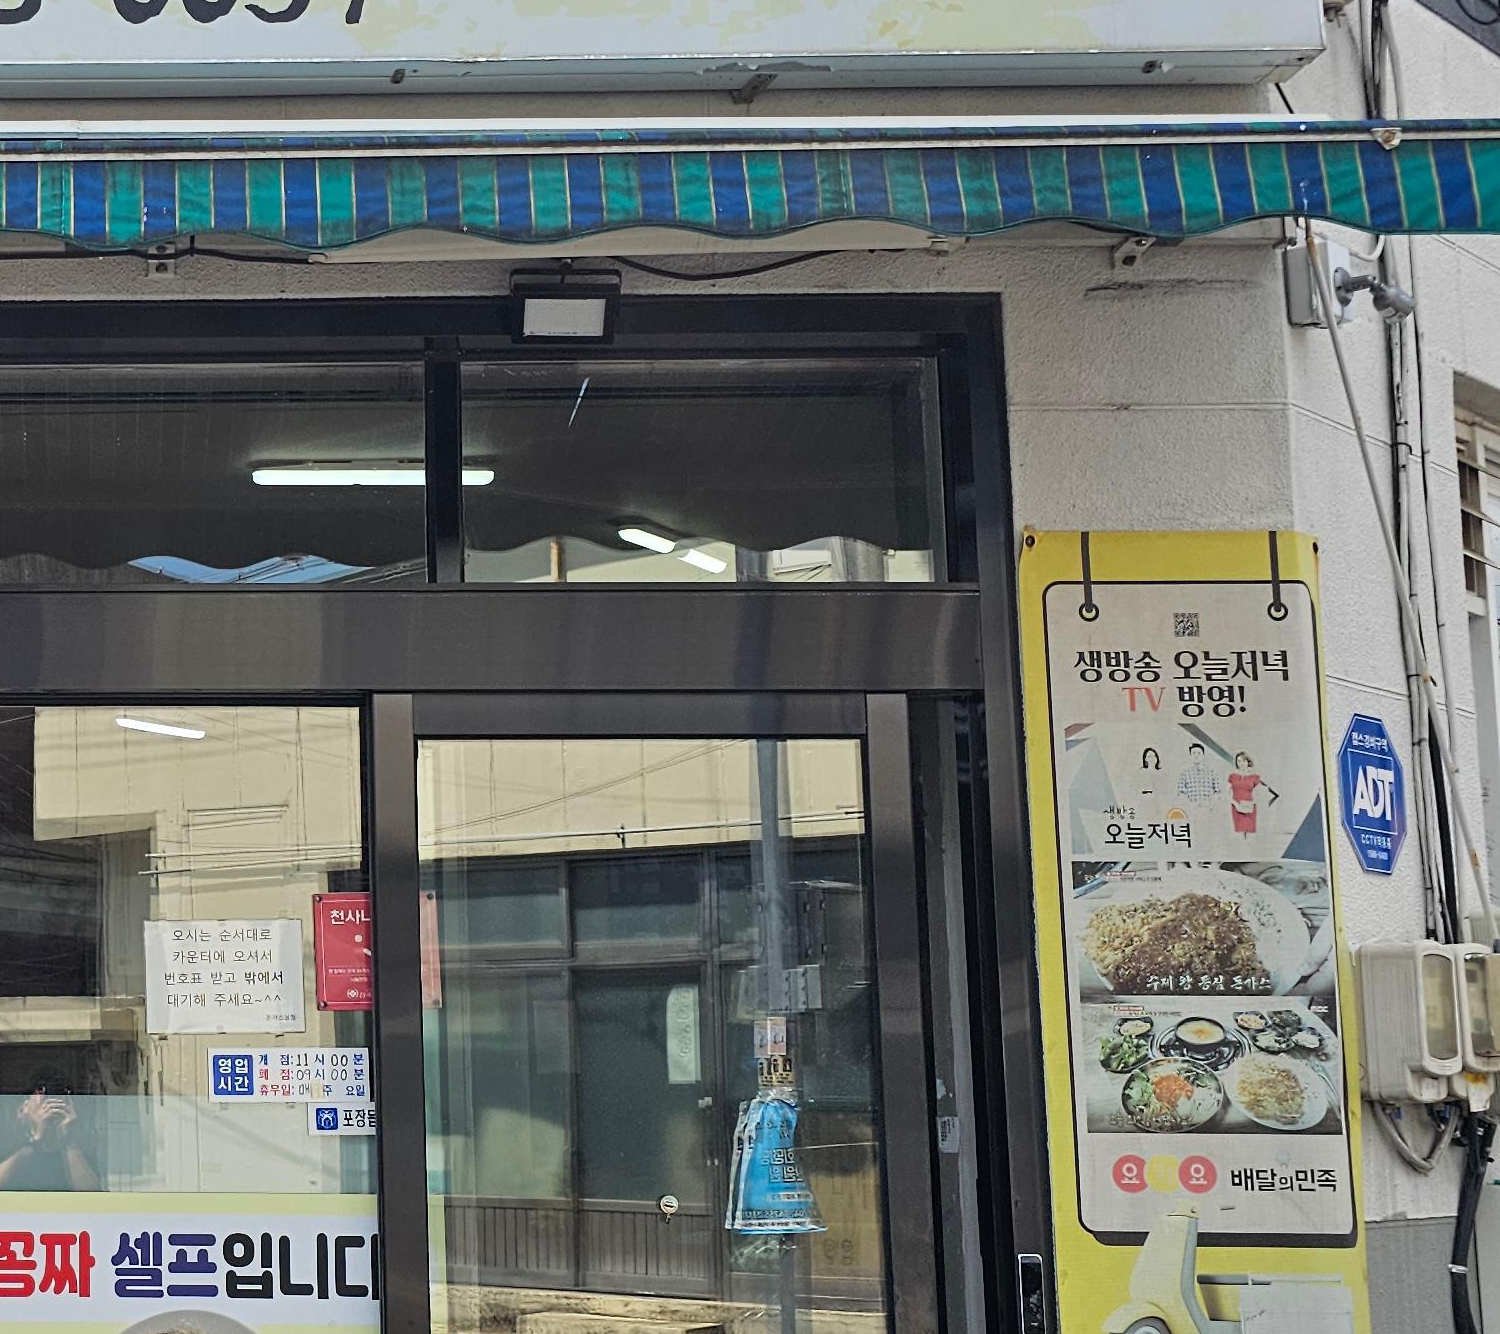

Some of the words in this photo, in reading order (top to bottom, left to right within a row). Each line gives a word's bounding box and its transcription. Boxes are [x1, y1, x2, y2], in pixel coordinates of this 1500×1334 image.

[1073, 650, 1162, 684] 생방송
[1173, 650, 1289, 682] 오늘저녁
[1122, 686, 1166, 713] TV
[1177, 686, 1246, 717] 방영!
[1353, 765, 1394, 821] ADT
[1104, 822, 1192, 850] 오늘저녁
[172, 928, 211, 942] 오시는
[220, 928, 272, 942] 순서대로
[172, 949, 225, 964] 카운터에
[233, 949, 273, 964] 오셔서
[164, 972, 203, 985] 번호표
[211, 972, 236, 985] 받고
[244, 971, 284, 985] 밖에서
[167, 993, 206, 1007] 대기해
[218, 1058, 248, 1073] 영업
[218, 1076, 249, 1092] 시간
[1230, 1168, 1338, 1192] 배달의민족
